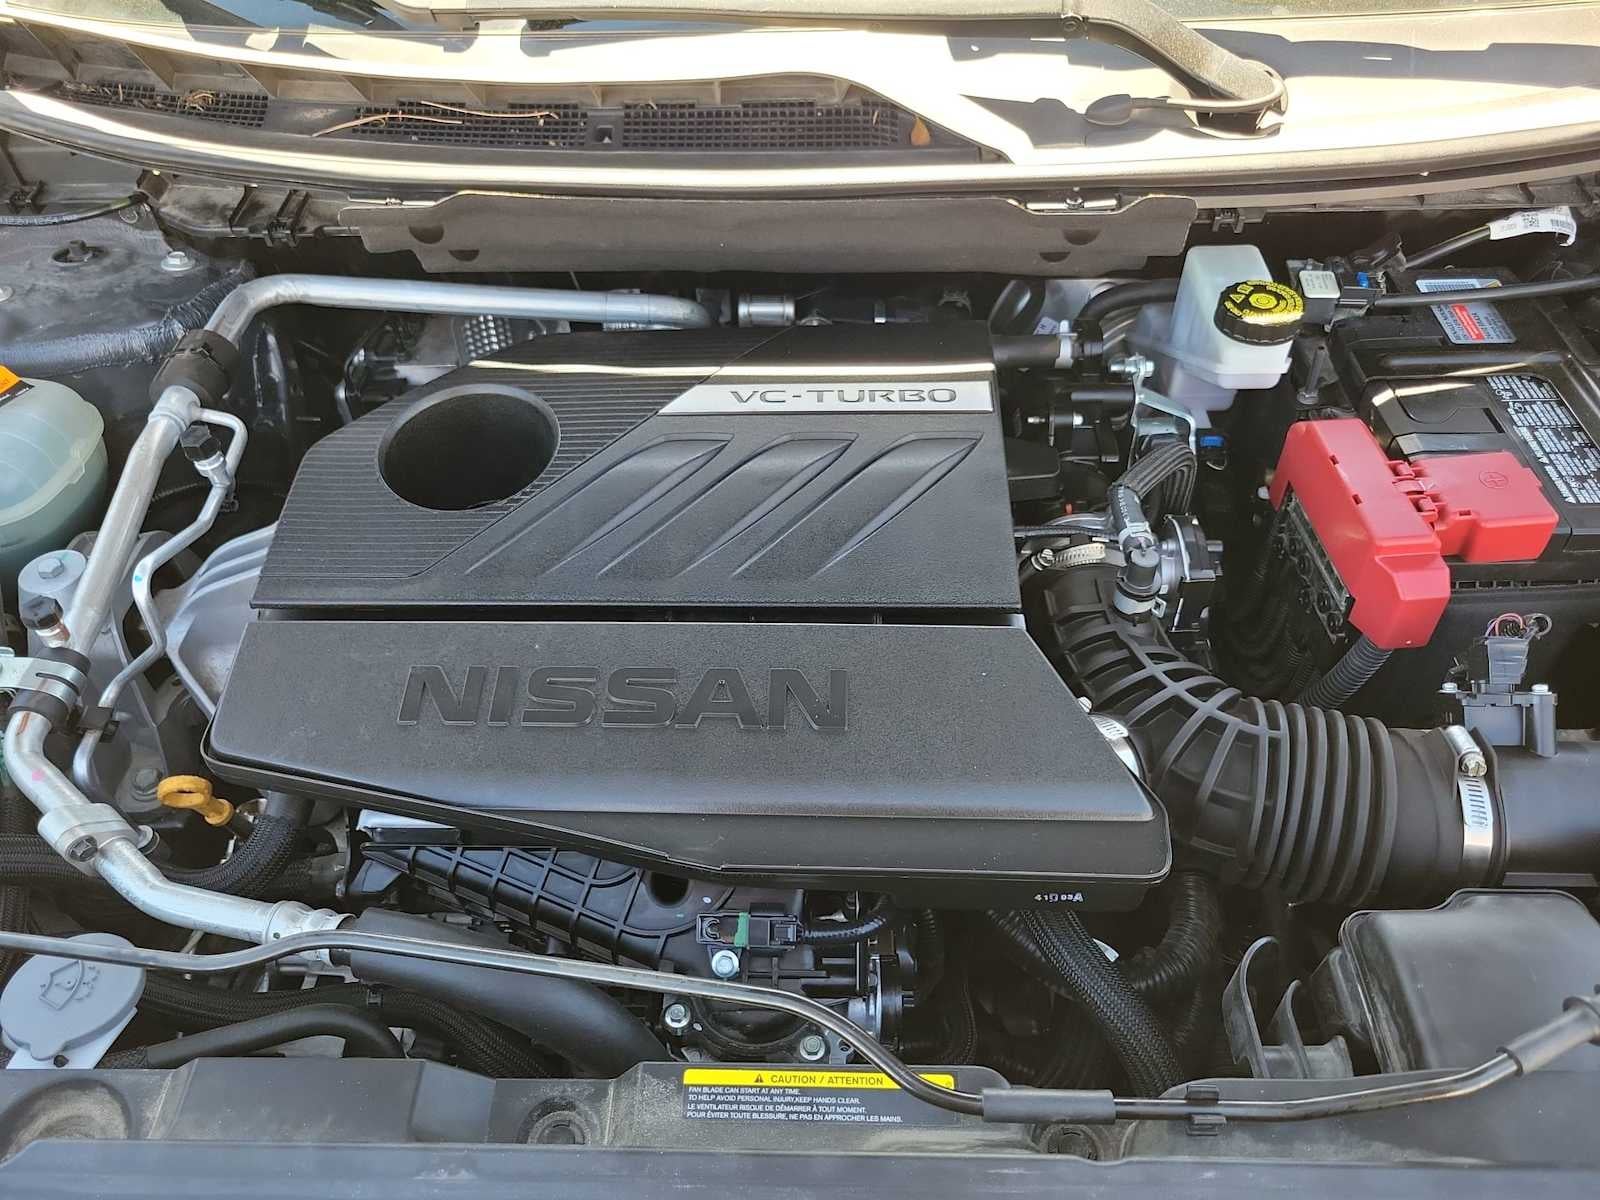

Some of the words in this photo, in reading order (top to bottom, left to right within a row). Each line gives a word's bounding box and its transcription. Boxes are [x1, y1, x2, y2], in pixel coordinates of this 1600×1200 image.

[730, 387, 957, 404] VC-TURBO
[397, 664, 848, 731] NISSAN
[770, 1074, 816, 1084] CAUTION
[827, 1076, 883, 1086] ATTENTION
[716, 1094, 736, 1102] AVOID
[813, 1096, 836, 1104] HANDS
[697, 1103, 738, 1111] VENTILATEUR
[739, 1104, 764, 1112] RISQUE
[775, 1103, 812, 1112] DÉMARRER
[818, 1105, 837, 1113] TOUT
[837, 1106, 867, 1114] MOMENT.
[706, 1110, 729, 1119] ÉVITER
[752, 1112, 788, 1120] BLESSURE,
[813, 1113, 823, 1121] EN
[880, 1115, 903, 1123] MAINS.
